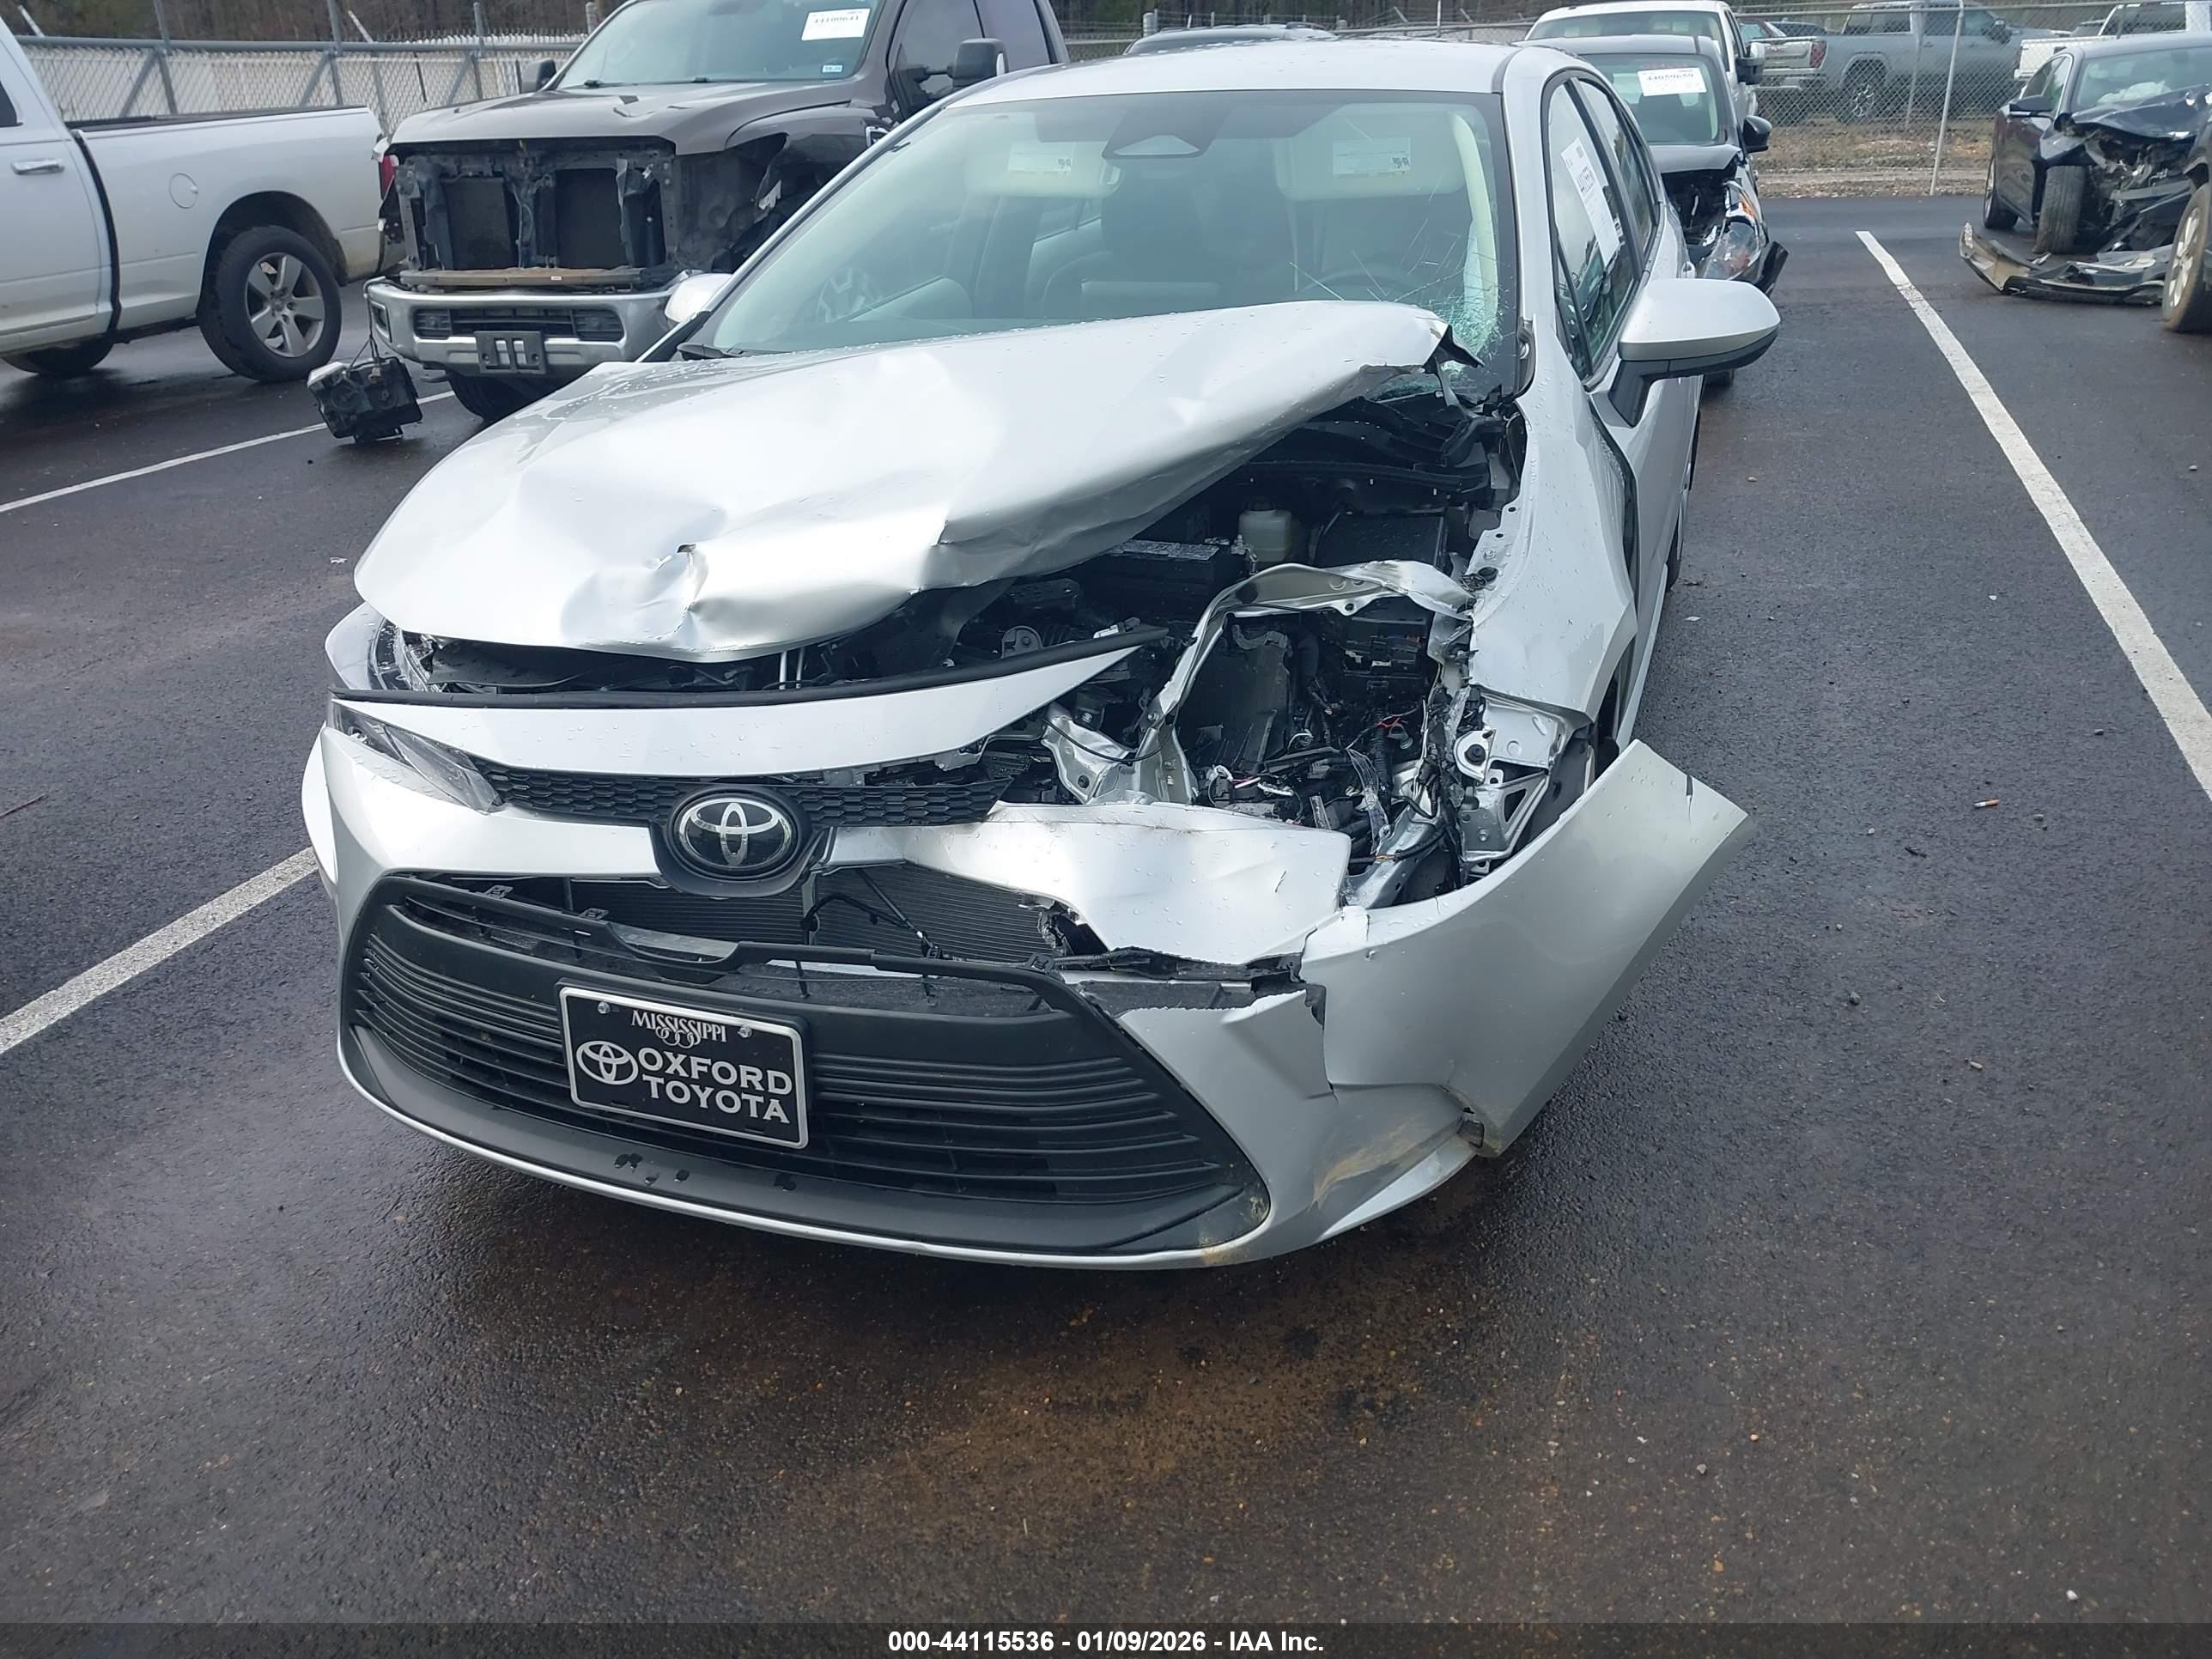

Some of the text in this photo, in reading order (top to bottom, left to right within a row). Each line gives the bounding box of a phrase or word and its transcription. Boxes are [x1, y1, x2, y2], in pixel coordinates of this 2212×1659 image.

[631, 1011, 727, 1048] MISSISSIPPI
[638, 1048, 793, 1095] OXFORD
[642, 1075, 791, 1124] TOYOTA
